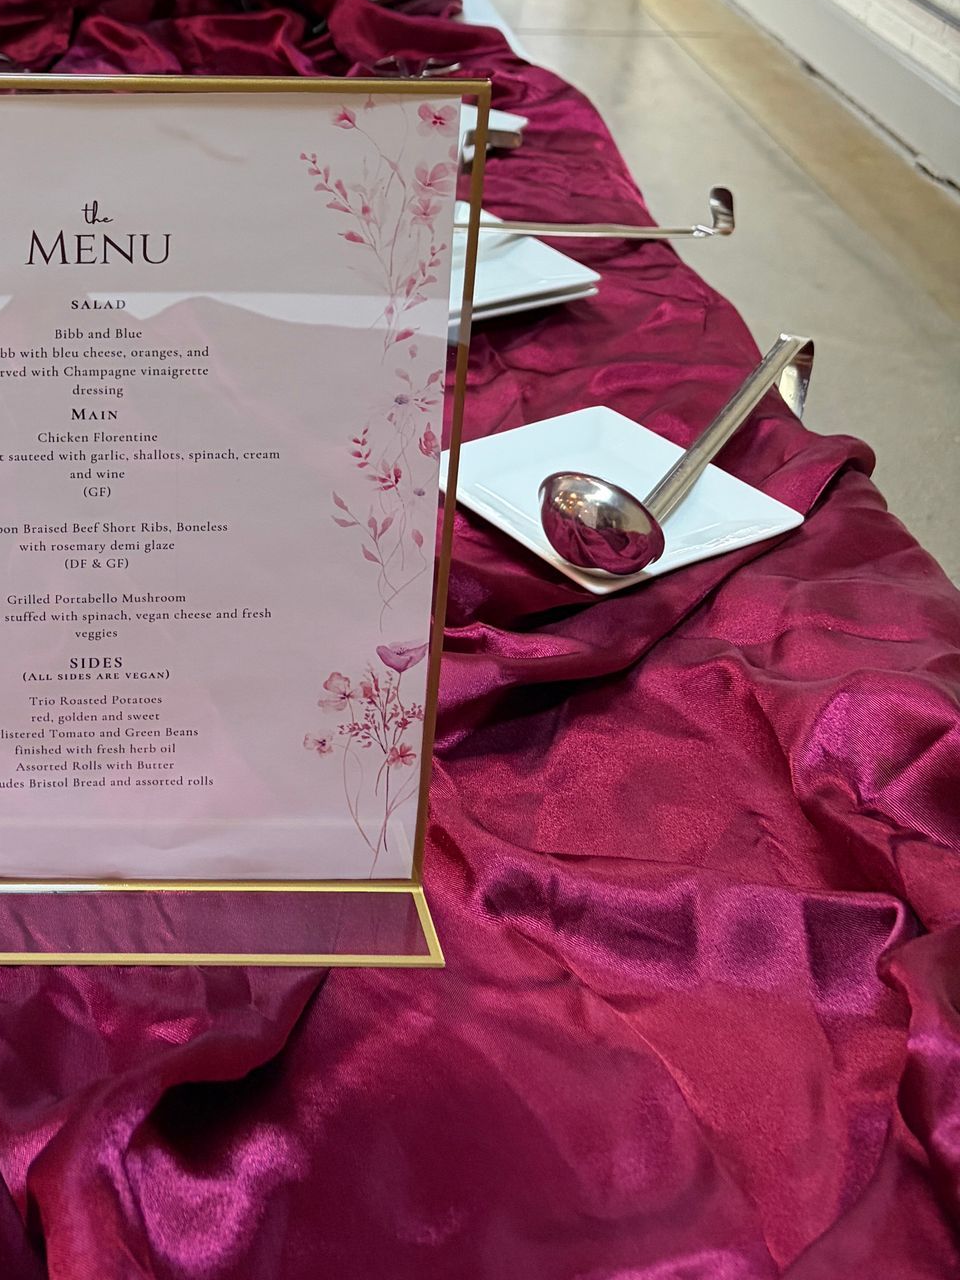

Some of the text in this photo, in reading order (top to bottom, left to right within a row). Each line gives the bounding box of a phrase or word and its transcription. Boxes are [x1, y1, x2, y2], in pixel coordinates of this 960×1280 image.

[81, 199, 114, 225] the
[24, 229, 171, 266] MENU
[71, 299, 126, 310] SALAD
[55, 327, 143, 340] Bibb and Blue
[19, 346, 48, 359] with
[52, 346, 79, 359] bleu
[82, 346, 127, 359] cheese,
[130, 349, 183, 361] oranges,
[186, 345, 209, 358] and
[31, 365, 59, 377] with
[63, 365, 137, 381] Champagne
[140, 365, 209, 380] vinaigrette
[72, 383, 124, 399] dressing
[37, 431, 158, 443] Chicken Florentine
[58, 449, 87, 462] with
[90, 449, 130, 465] garlic,
[133, 448, 185, 461] shallots,
[188, 448, 239, 463] spinach,
[242, 451, 280, 460] cream
[69, 467, 125, 480] and wine
[83, 486, 112, 498] (GF)
[23, 522, 68, 534] Braised
[72, 521, 101, 534] Beef
[102, 521, 136, 533] Short
[140, 521, 172, 534] Ribs,
[176, 520, 228, 532] Boneless
[19, 539, 175, 554] with rosemary demi glaze
[64, 557, 129, 570] (DF & GF)
[6, 592, 186, 605] Grilled Portabello Mushroom
[4, 610, 47, 622] stuffed
[50, 610, 78, 622] with
[81, 609, 132, 625] spinach,
[135, 612, 170, 624] vegan
[173, 608, 212, 620] cheese
[215, 608, 238, 619] and
[242, 607, 272, 619] fresh
[74, 628, 118, 642] veggies
[69, 656, 123, 669] SIDES
[28, 694, 163, 707] Trio Roasted Potatoes
[31, 710, 160, 726] red, golden and sweet
[48, 728, 96, 739] Tomato
[99, 727, 121, 738] and
[124, 727, 161, 738] Green
[165, 727, 199, 737] Beans
[14, 743, 176, 756] finished with fresh herb oil
[15, 759, 175, 772] Assorted Rolls with Butter
[29, 776, 68, 789] Bristol
[73, 776, 106, 788] Bread
[110, 776, 132, 787] and
[135, 775, 184, 787] assorted
[187, 775, 214, 786] rolls
